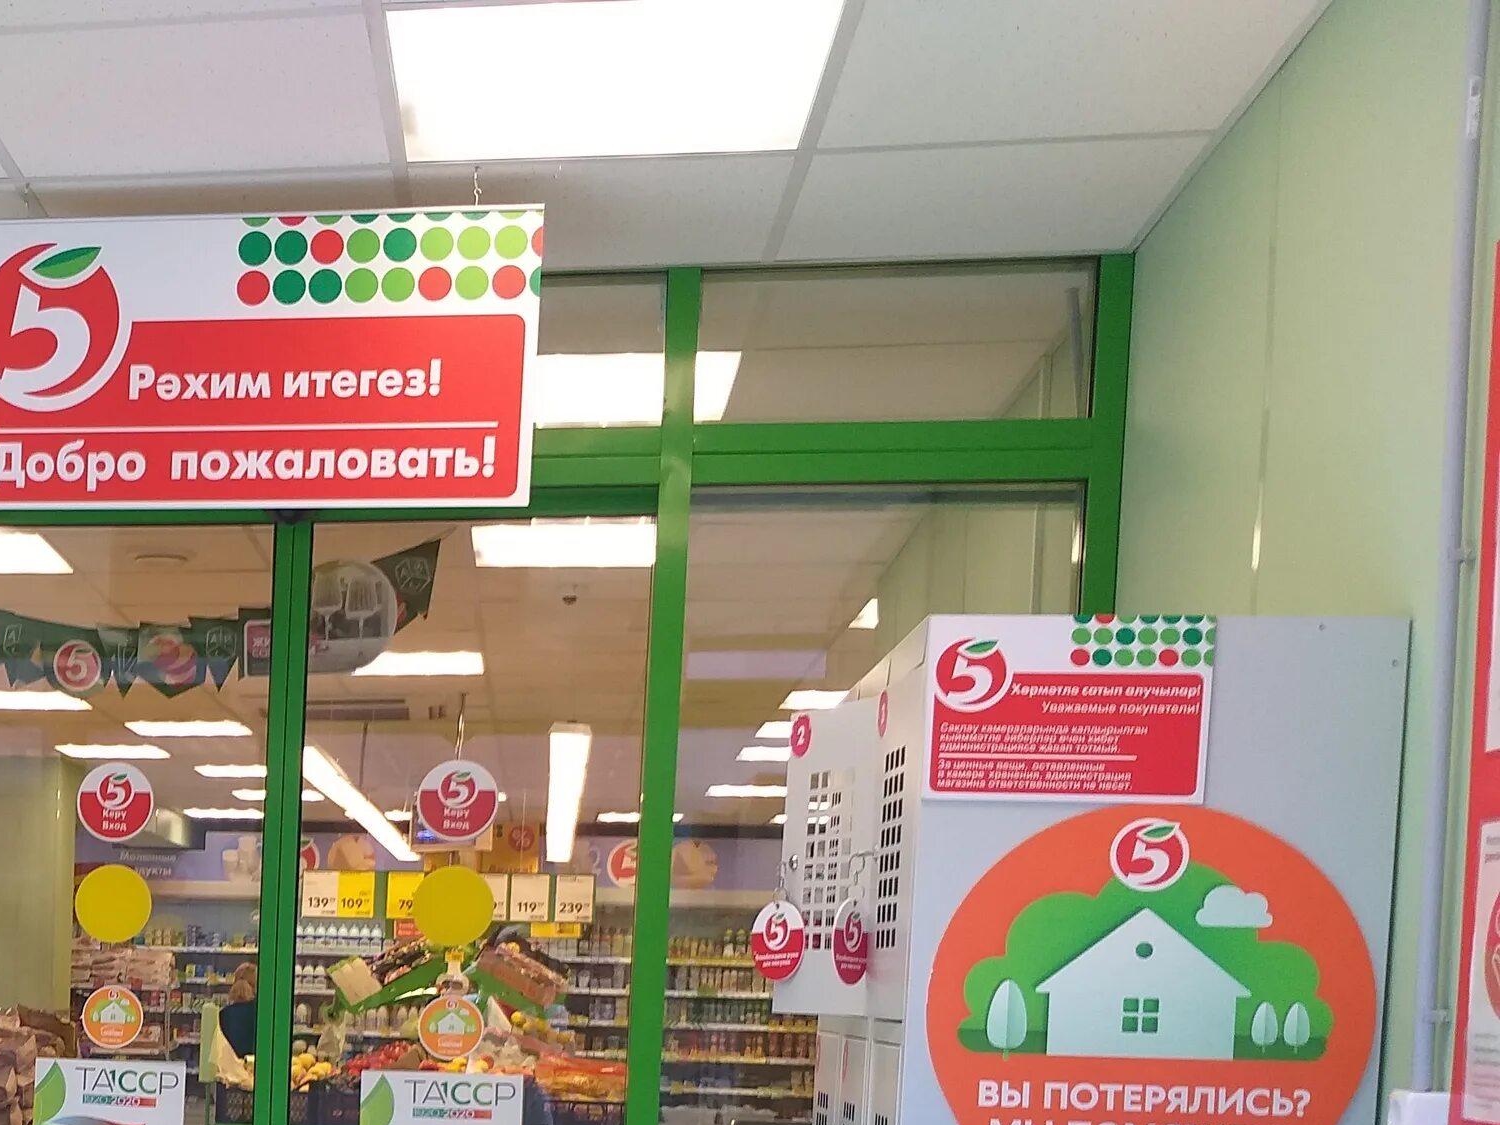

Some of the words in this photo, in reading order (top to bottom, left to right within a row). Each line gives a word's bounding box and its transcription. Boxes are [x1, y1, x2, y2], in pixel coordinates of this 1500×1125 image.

[128, 364, 271, 401] Рәхим
[283, 357, 442, 398] итегез!
[171, 435, 496, 481] пожаловать!
[1082, 684, 1123, 696] сатып
[1125, 684, 1201, 699] алучылар!
[1041, 700, 1117, 714] Уважаемые
[1119, 702, 1201, 716] покупатели!
[794, 724, 806, 747] 2
[938, 759, 951, 769] За
[953, 761, 995, 770] ценные
[1032, 762, 1106, 772] оставленные
[945, 770, 985, 781] камере
[1045, 772, 1132, 783] администрация
[937, 779, 986, 789] магазина
[988, 780, 1081, 790] ответственности
[1082, 781, 1097, 790] не
[102, 821, 127, 831] Вход
[443, 820, 470, 831] Вход
[135, 867, 172, 877] дукты
[977, 1079, 1030, 1109] ВЫ
[1043, 1081, 1312, 1118] ПОТЕРЯЛИСЬ?
